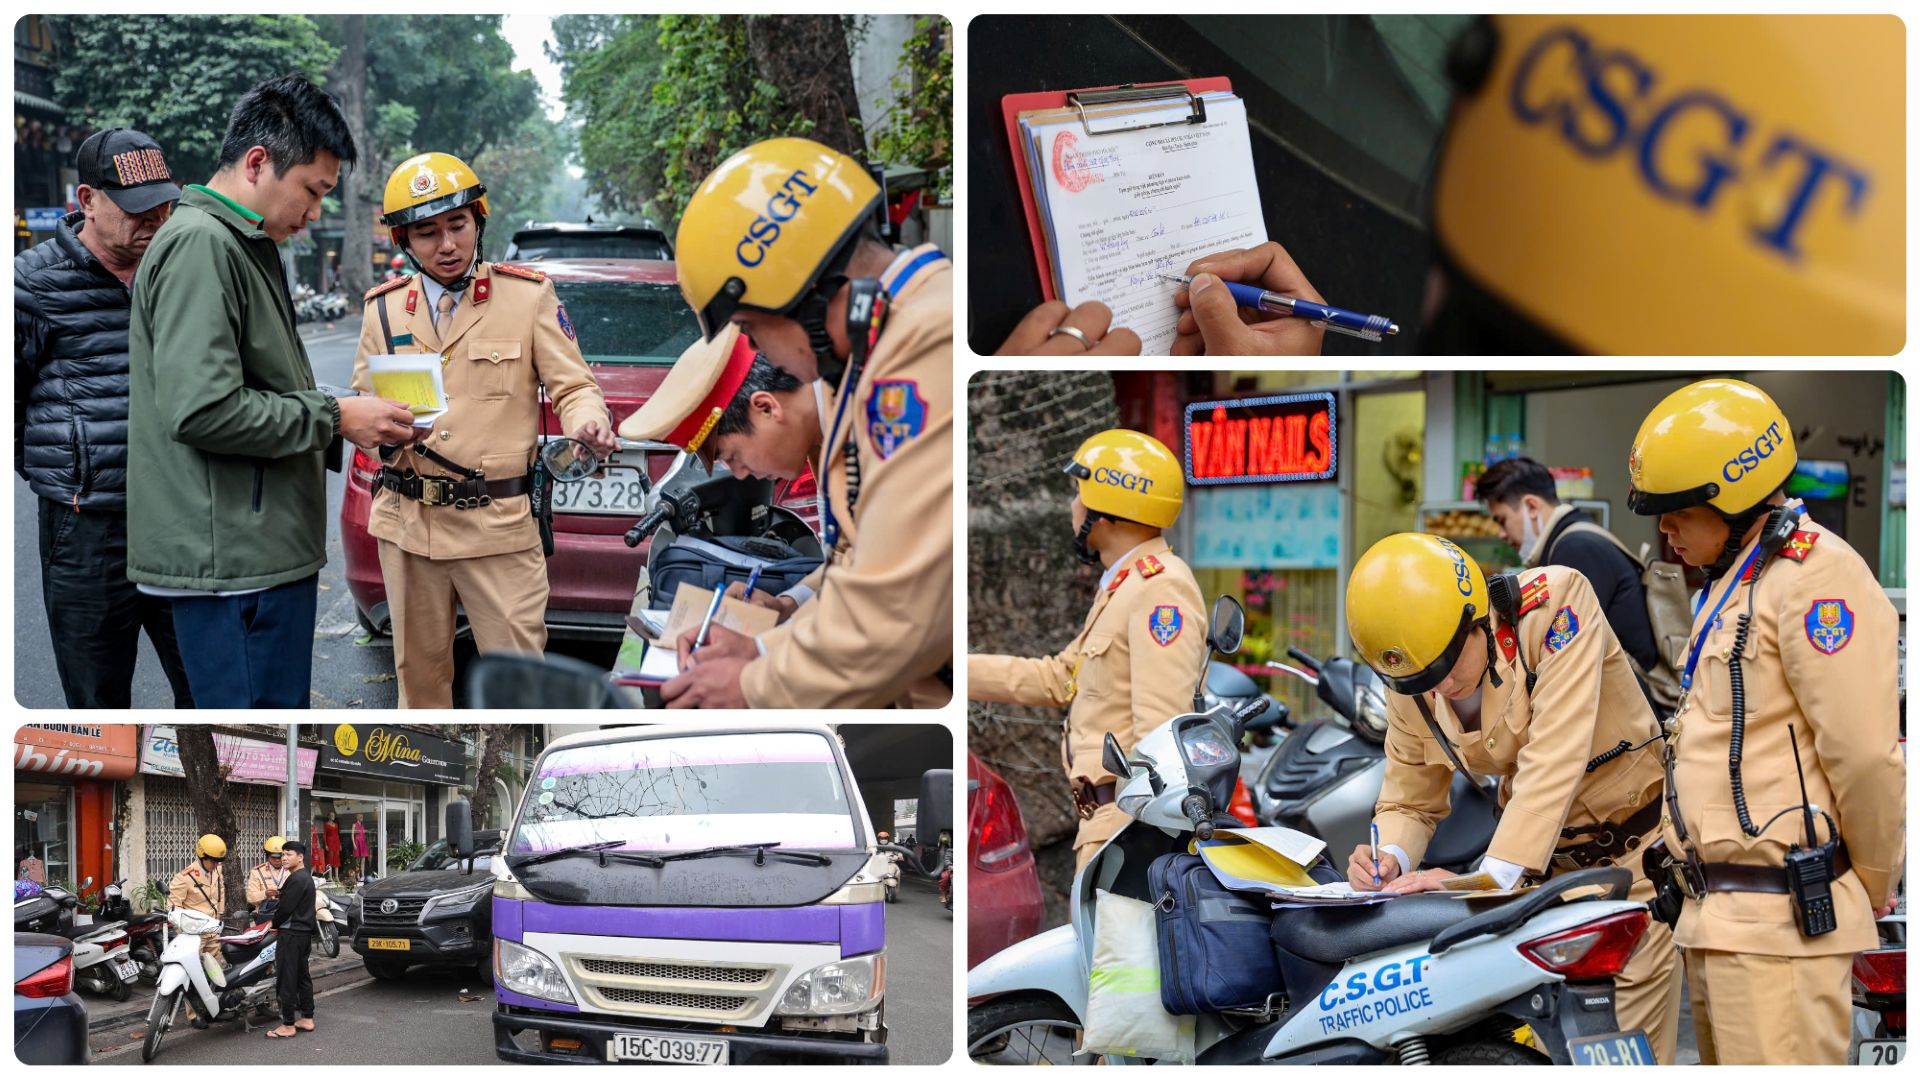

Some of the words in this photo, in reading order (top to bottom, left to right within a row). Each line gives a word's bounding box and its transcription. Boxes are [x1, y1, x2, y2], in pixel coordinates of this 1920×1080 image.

[1507, 24, 1872, 268] CSGT
[736, 169, 818, 268] CSGT
[1247, 410, 1332, 475] NAILS
[1722, 421, 1784, 483] CSGT
[553, 480, 643, 510] 373.28
[1094, 466, 1154, 495] CSGT
[364, 727, 421, 763] Mina
[1319, 954, 1432, 1011] C.S.G.T
[1584, 997, 1610, 1006] HONDA
[1318, 1004, 1374, 1036] TRAFFIC
[1374, 986, 1433, 1021] POLICE
[620, 1037, 724, 1064] 15C-039.77
